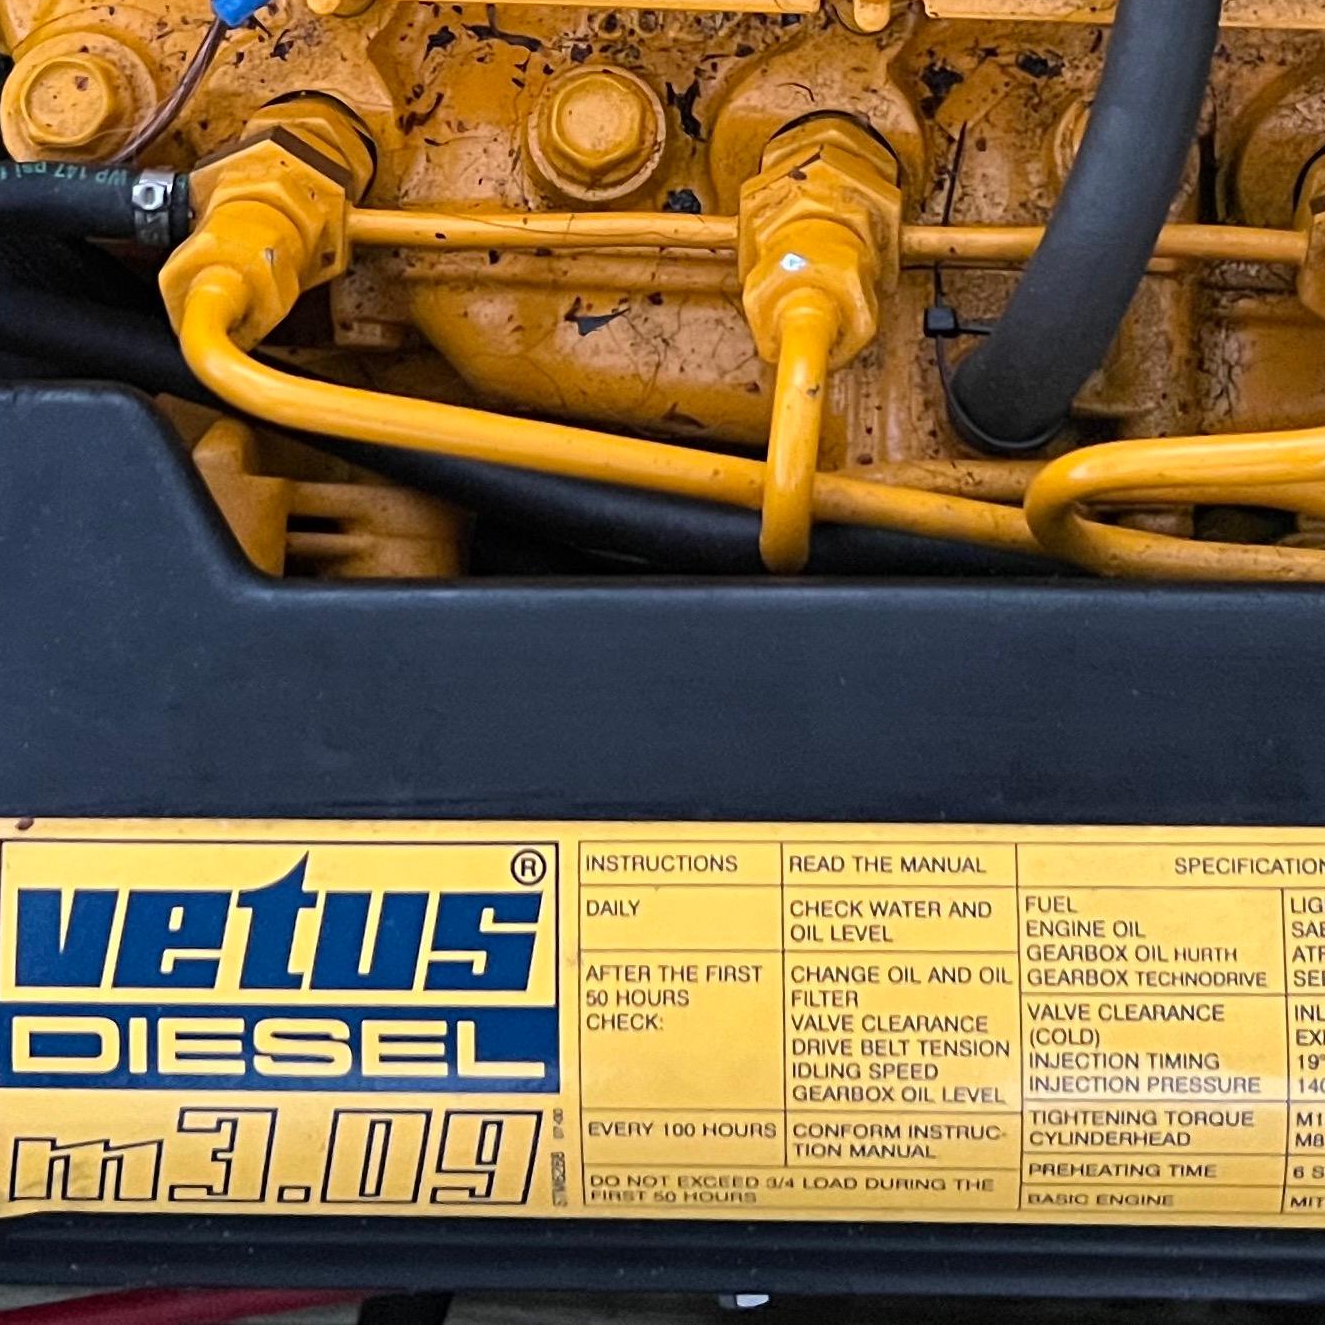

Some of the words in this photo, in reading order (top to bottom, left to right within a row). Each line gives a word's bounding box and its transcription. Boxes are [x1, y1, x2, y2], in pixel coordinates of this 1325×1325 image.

[53, 163, 88, 183] 147
[586, 854, 738, 873] INSTRUCTIONS
[789, 855, 845, 873] READ
[852, 856, 893, 874] THE
[900, 856, 987, 874] MANUAL
[586, 899, 640, 917] DAILY
[789, 899, 863, 918] CHECK
[869, 900, 942, 919] WATER
[948, 901, 992, 919] AND
[1025, 895, 1078, 914] FUEL
[15, 850, 544, 992] vetus
[1026, 919, 1106, 938] ENGINE
[1112, 920, 1146, 938] OIL
[790, 924, 824, 943] OIL
[830, 924, 893, 943] LEVEL
[1026, 944, 1128, 963] GEARBOX
[1134, 944, 1169, 963] OIL
[1174, 947, 1238, 963] HURTH
[585, 964, 651, 983] AFTER
[658, 964, 698, 983] THE
[706, 964, 763, 983] FIRST
[790, 965, 880, 984] CHANGE
[887, 965, 922, 984] OIL
[927, 966, 972, 984] AND
[979, 966, 1013, 985] OIL
[1027, 968, 1129, 987] GEARBOX
[1135, 970, 1267, 988] TECHNODRIVE
[586, 989, 609, 1008] 50
[616, 989, 690, 1007] HOURS
[791, 989, 859, 1008] FILTER
[1027, 1002, 1091, 1021] VALVE
[1097, 1003, 1225, 1022] CLEARANCE
[791, 1014, 854, 1033] VALVE
[861, 1014, 988, 1034] CLEARANCE
[11, 1016, 546, 1077] DIESEL
[1029, 1027, 1100, 1049] (COLD)
[792, 1038, 853, 1057] DRIVE
[860, 1039, 910, 1057] BELT
[917, 1039, 1010, 1058] TENSION
[1029, 1051, 1140, 1070] INJECTION
[1146, 1052, 1220, 1070] TIMING
[792, 1062, 861, 1080] IDLING
[868, 1062, 939, 1081] SPEED
[1029, 1075, 1140, 1094] INJECTION
[1147, 1075, 1261, 1094] PRESSURE
[792, 1085, 895, 1103] GEARBOX
[901, 1086, 935, 1103] OIL
[942, 1086, 1006, 1104] LEVEL
[1031, 1109, 1158, 1126] TIGHTENING
[1164, 1110, 1254, 1128] TORQUE
[588, 1121, 654, 1137] EVERY
[664, 1122, 696, 1138] 100
[702, 1122, 777, 1139] HOURS
[792, 1123, 901, 1140] CONFORM
[908, 1124, 1006, 1141] INSTRUC-
[1029, 1130, 1191, 1147] CYLINDERHEAD
[8, 1106, 544, 1205] m3.09
[794, 1143, 842, 1158] TION
[849, 1143, 936, 1159] MANUAL
[1028, 1162, 1161, 1177] PREHEATING
[1169, 1164, 1216, 1178] TIME
[1292, 1165, 1305, 1179] 6
[589, 1175, 621, 1189] DO
[627, 1174, 667, 1188] NOT
[677, 1175, 760, 1189] EXCEED
[802, 1176, 858, 1190] LOAD
[865, 1177, 946, 1191] DURING
[953, 1178, 995, 1192] THE
[590, 1190, 644, 1202] FIRST
[653, 1190, 677, 1204] 50
[683, 1191, 757, 1203] HOURS
[1095, 1194, 1173, 1206] ENGINE
